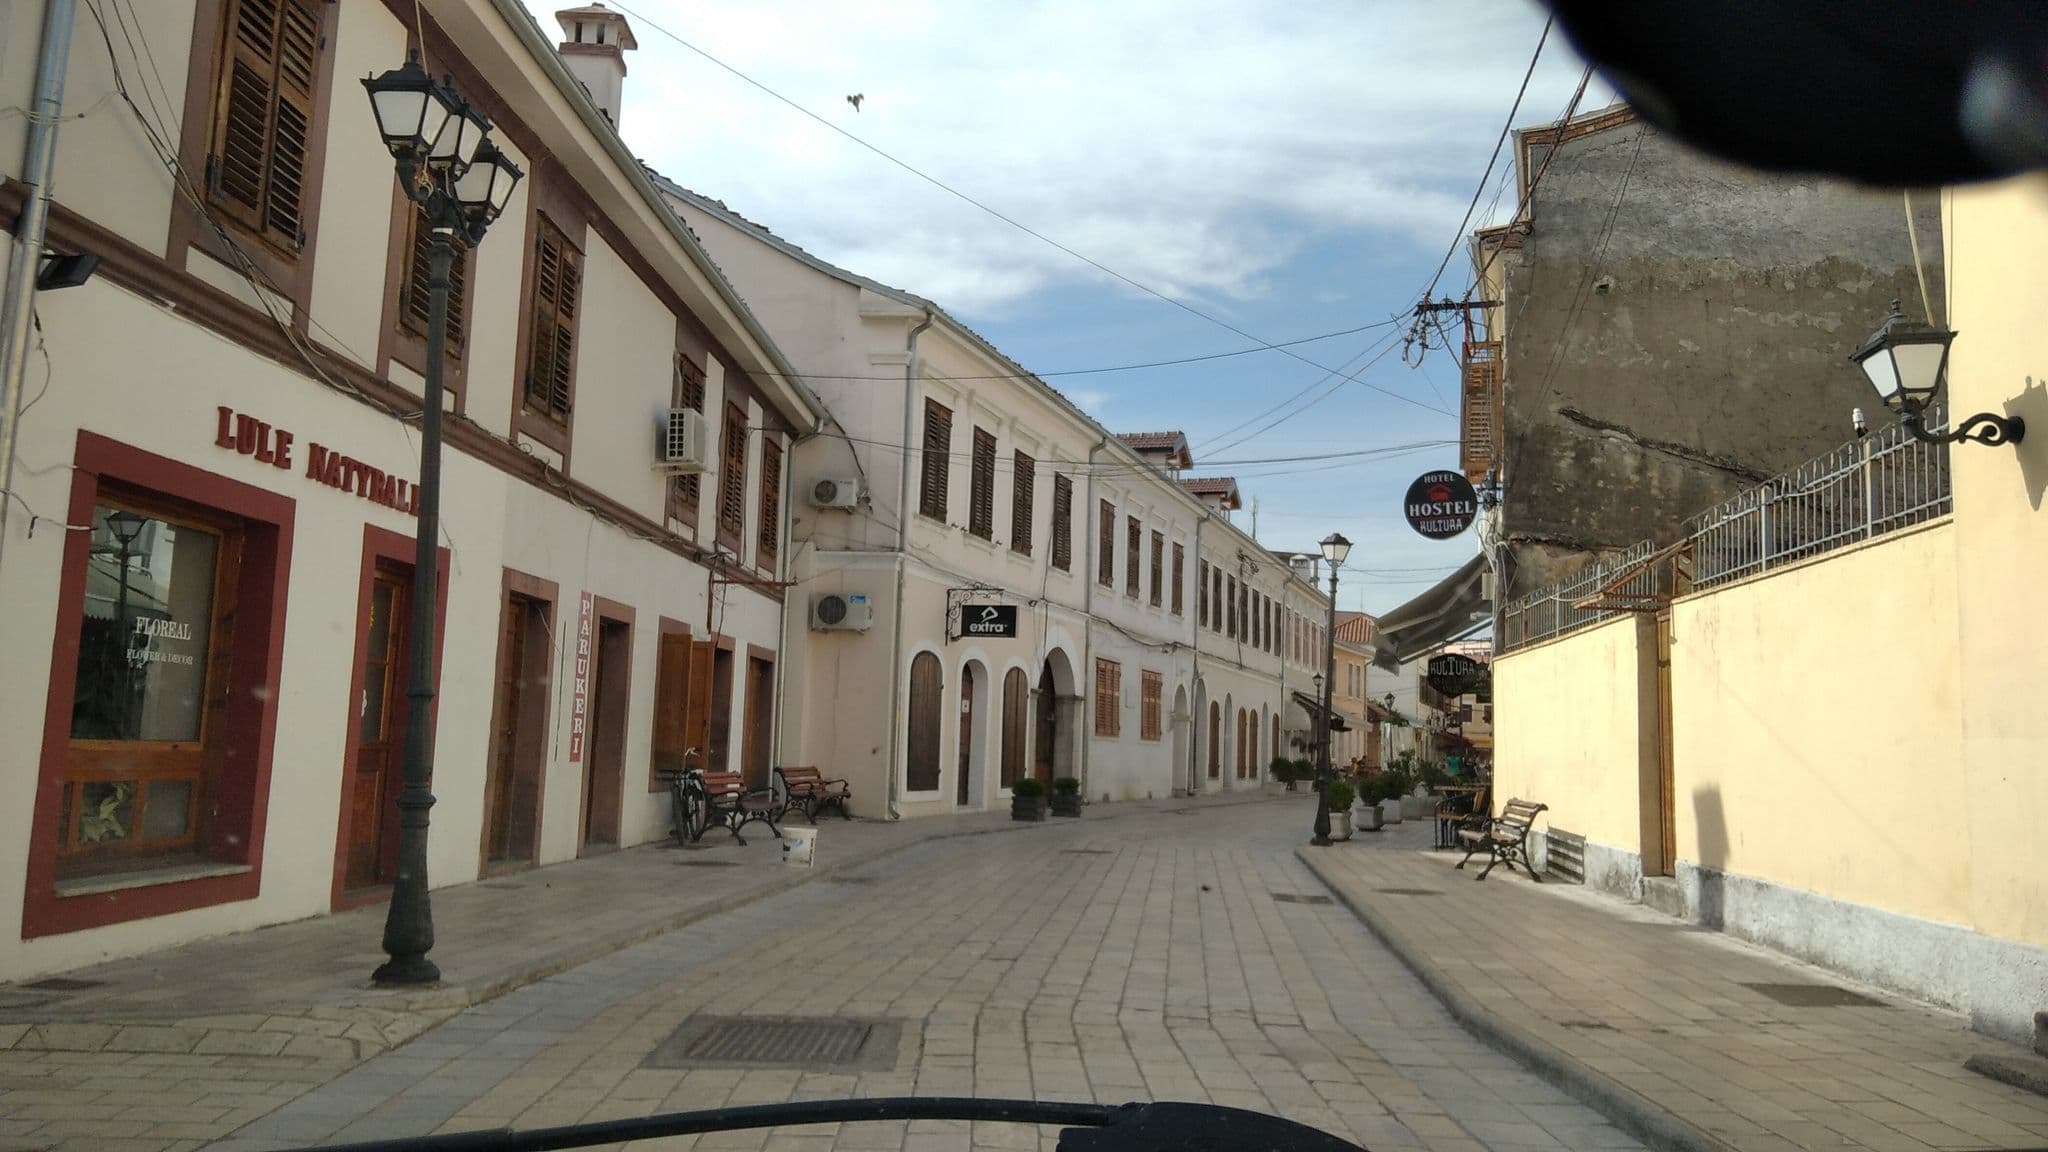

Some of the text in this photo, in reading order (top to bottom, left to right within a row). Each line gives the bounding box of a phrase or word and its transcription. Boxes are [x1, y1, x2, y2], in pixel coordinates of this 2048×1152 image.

[215, 406, 294, 470] LULE
[1424, 473, 1455, 484] HOTEL
[1409, 500, 1474, 517] HOSTEL
[1420, 519, 1463, 533] KULTURA
[135, 616, 192, 640] FLOREAL
[969, 621, 1004, 633] extra
[1430, 657, 1474, 676] KULTURA
[572, 600, 591, 753] PARUKERI
